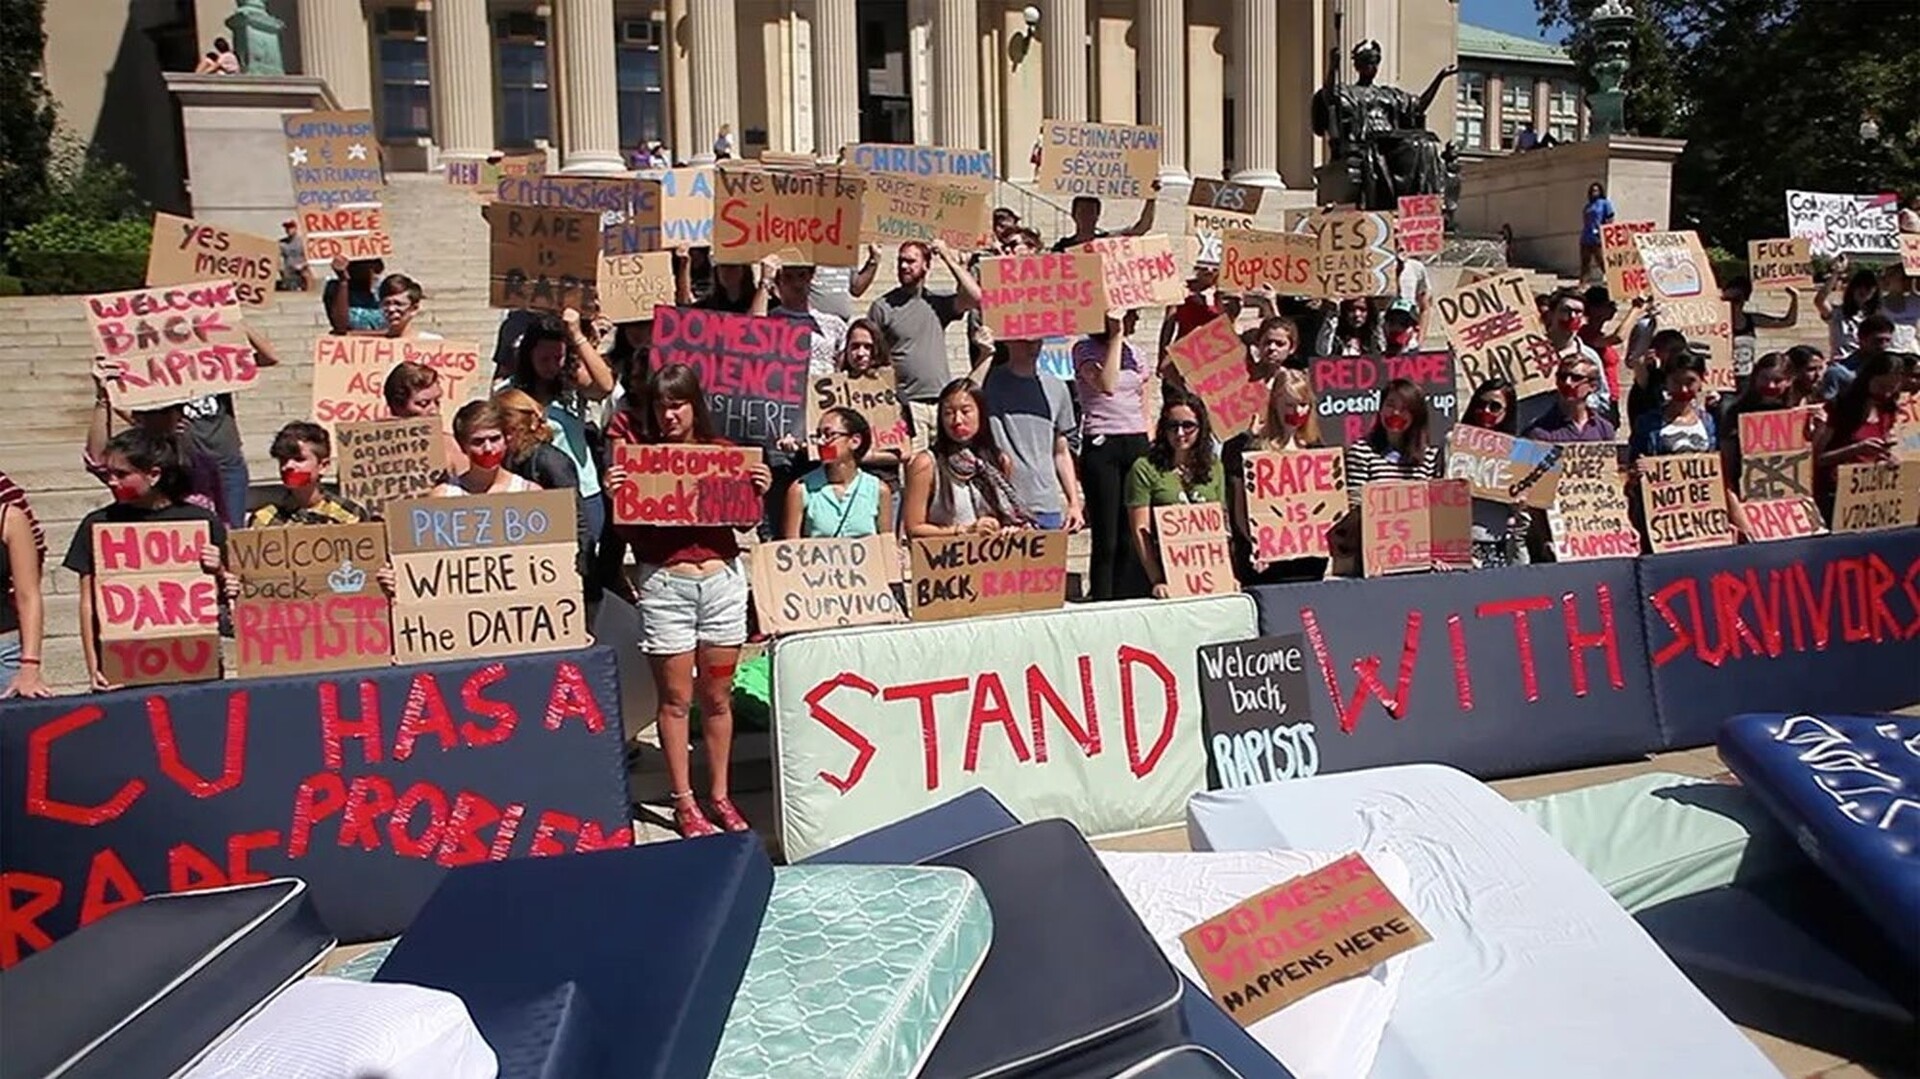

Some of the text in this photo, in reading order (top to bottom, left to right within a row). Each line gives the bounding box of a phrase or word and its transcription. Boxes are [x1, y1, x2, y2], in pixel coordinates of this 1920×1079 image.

[1051, 125, 1159, 150] SEMINARIAN
[855, 146, 993, 179] CHRISTIANS
[1062, 158, 1133, 180] SEXUAL
[719, 167, 765, 198] We
[1054, 178, 1140, 197] VIOLENCE
[1208, 182, 1248, 209] YES
[304, 211, 362, 232] RAPE
[889, 198, 930, 218] JUST
[1193, 213, 1253, 231] means
[1401, 196, 1438, 217] YES
[507, 210, 582, 242] RAPE
[720, 199, 855, 250] Silenced.
[1309, 217, 1368, 252] YES
[307, 231, 392, 259] RED TAPE
[1402, 233, 1440, 252] YES
[1757, 242, 1795, 260] FUCK
[194, 251, 273, 282] means
[605, 254, 645, 276] YES
[1000, 254, 1080, 286] RAPE
[1104, 250, 1176, 285] HAPPENS
[1223, 246, 1311, 291] Rapists
[1317, 270, 1373, 294] YES!
[89, 281, 240, 321] WELCOME
[231, 282, 266, 305] es
[980, 281, 1094, 310] HAPPENS
[1108, 283, 1153, 307] HERE
[1437, 277, 1526, 326] DON'T
[97, 312, 232, 357] BACK
[652, 305, 813, 361] DOMESTIC
[1003, 310, 1079, 337] HERE
[317, 339, 395, 366] FAITH
[1173, 320, 1240, 372] YES
[107, 345, 260, 393] RAPISTS
[814, 354, 897, 411] Silence
[1315, 352, 1449, 391] RED TAPE
[724, 398, 800, 441] HERE
[1210, 383, 1268, 429] YES
[1432, 393, 1456, 417] up
[1455, 427, 1509, 457] FUCK
[351, 456, 430, 479] QUEERS
[1256, 453, 1334, 499] RAPE
[1645, 458, 1719, 484] WE WILL
[1850, 464, 1900, 495] SILENCE
[617, 479, 699, 522] Back
[1651, 483, 1711, 509] NOT BE
[1842, 498, 1902, 529] VIOLENCE
[412, 506, 548, 548] PREZ BO
[1257, 521, 1332, 557] RAPE
[1376, 518, 1412, 541] IS
[1650, 508, 1731, 544] SILENCED
[100, 526, 207, 571] HOW
[230, 530, 377, 570] Welcome
[918, 535, 1048, 570] WELCOME
[1167, 542, 1225, 569] WITH
[405, 553, 557, 599] WHERE is
[916, 566, 1067, 607] BACK, RAPIST
[1186, 571, 1215, 593] US
[101, 581, 220, 631] DARE
[1649, 552, 1920, 668] SURVIVORS
[235, 596, 391, 666] RAPISTS
[400, 598, 578, 653] the DATA?
[105, 639, 212, 680] YOU
[1200, 646, 1302, 679] Welcome
[803, 580, 1628, 796] STAND WITH
[1227, 676, 1287, 714] back,
[25, 659, 607, 826] CU HAS A
[1212, 722, 1320, 790] RAPISTS
[1199, 854, 1374, 953] DOMESTIC
[1205, 883, 1392, 983] VIOLENCE
[1221, 916, 1411, 1013] HAPPENS HERE
